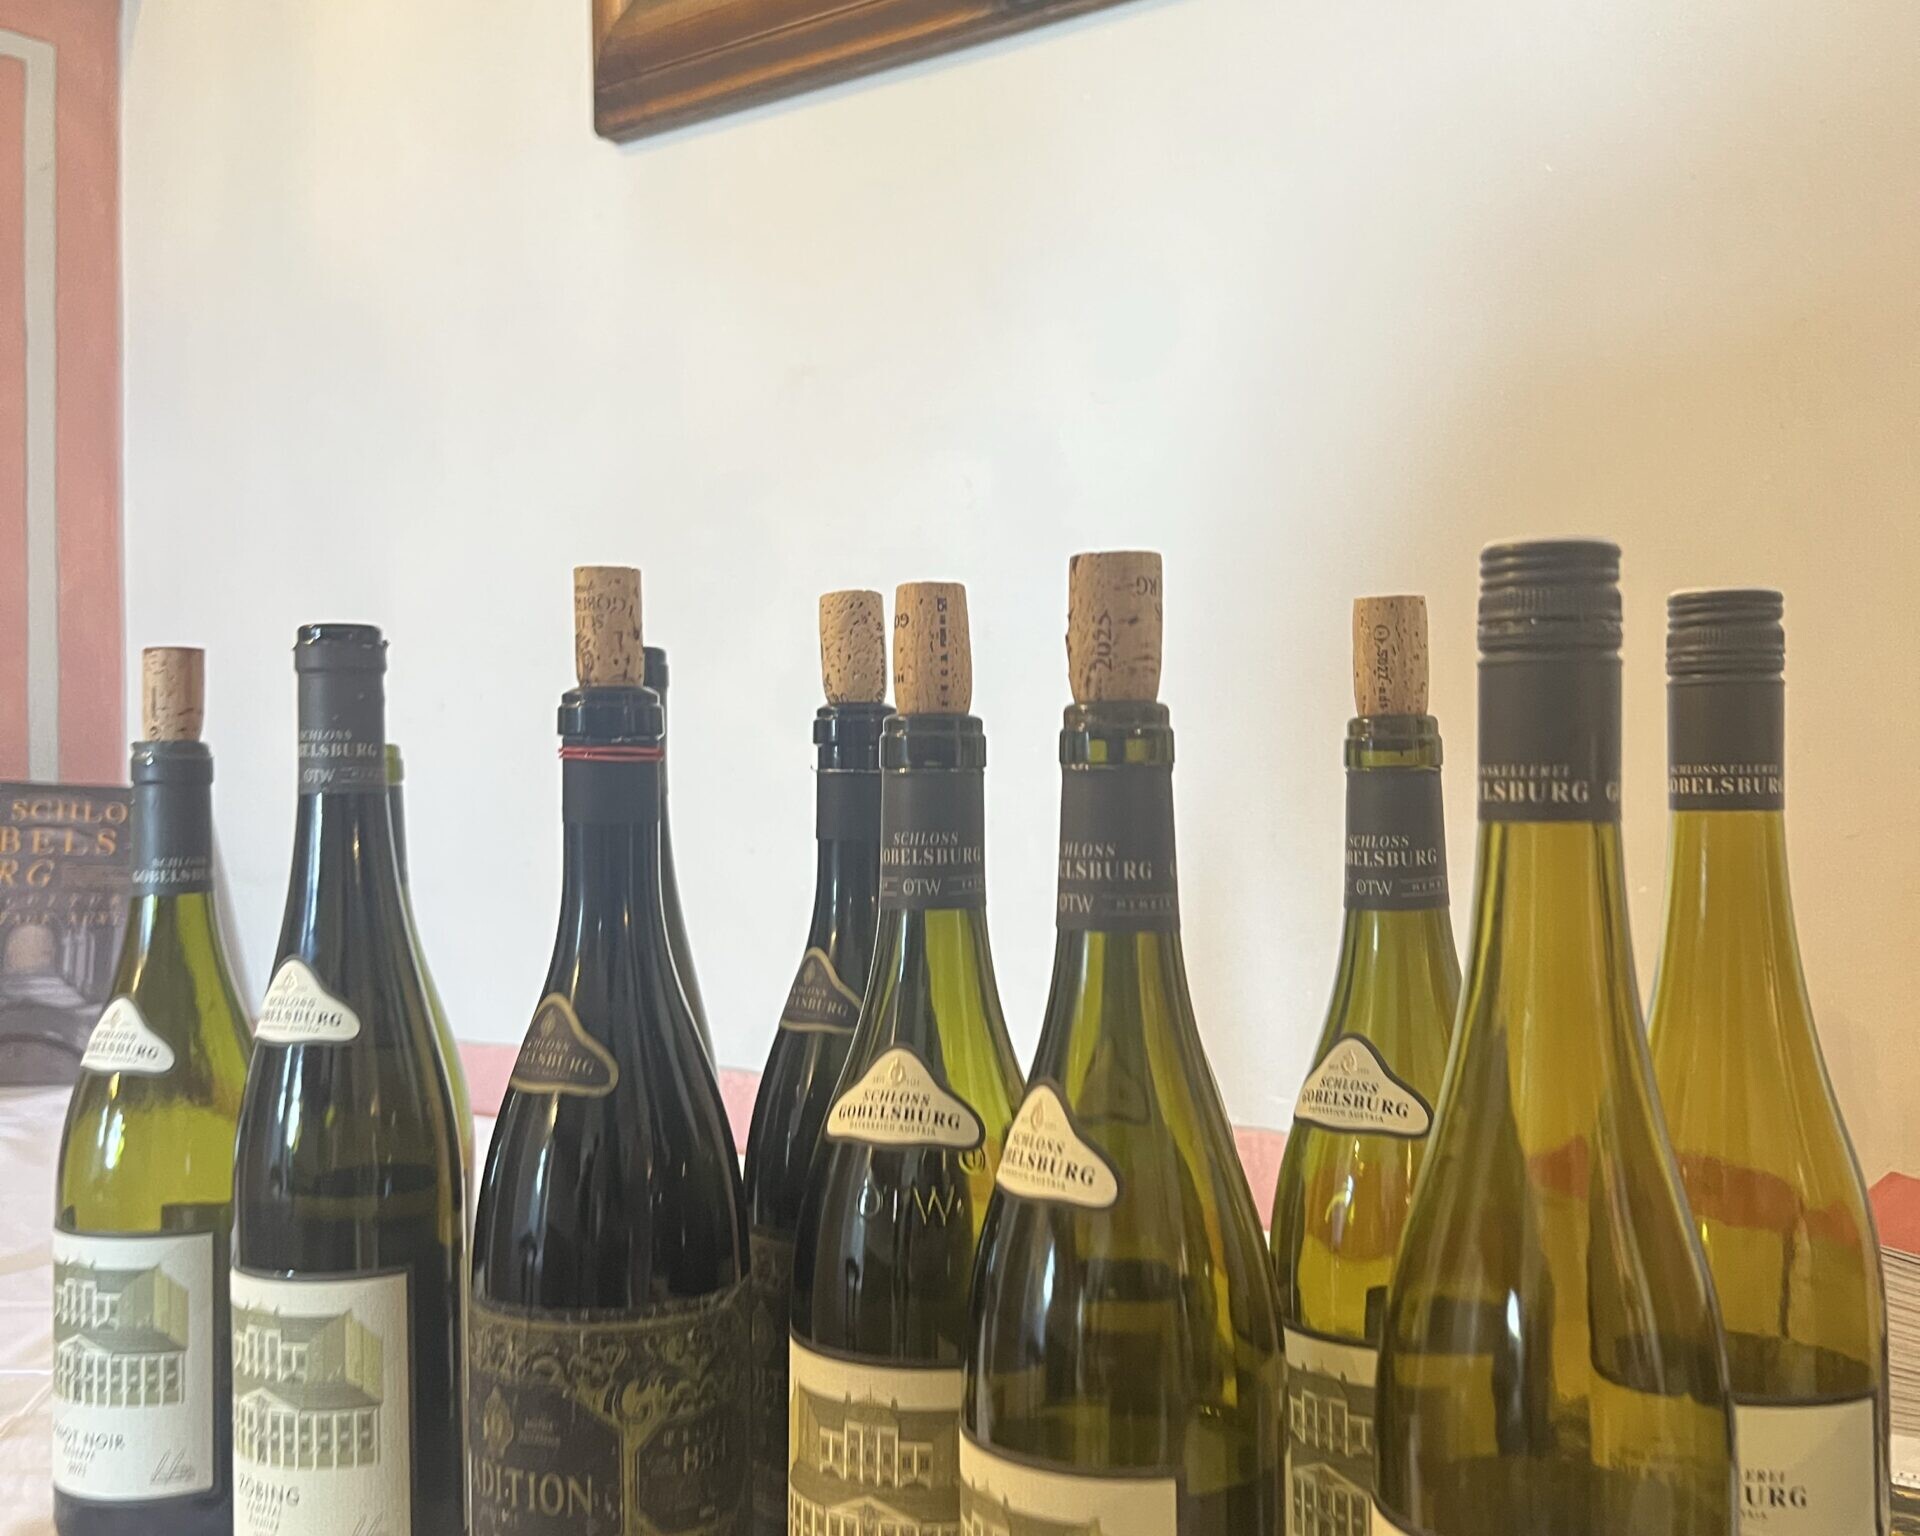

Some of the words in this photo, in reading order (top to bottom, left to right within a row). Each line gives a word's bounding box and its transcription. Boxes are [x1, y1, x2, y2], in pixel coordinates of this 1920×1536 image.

[893, 831, 960, 846] SCHLOSS
[863, 1089, 932, 1109] SCHLOSS
[838, 1102, 962, 1132] GOBELSBURG
